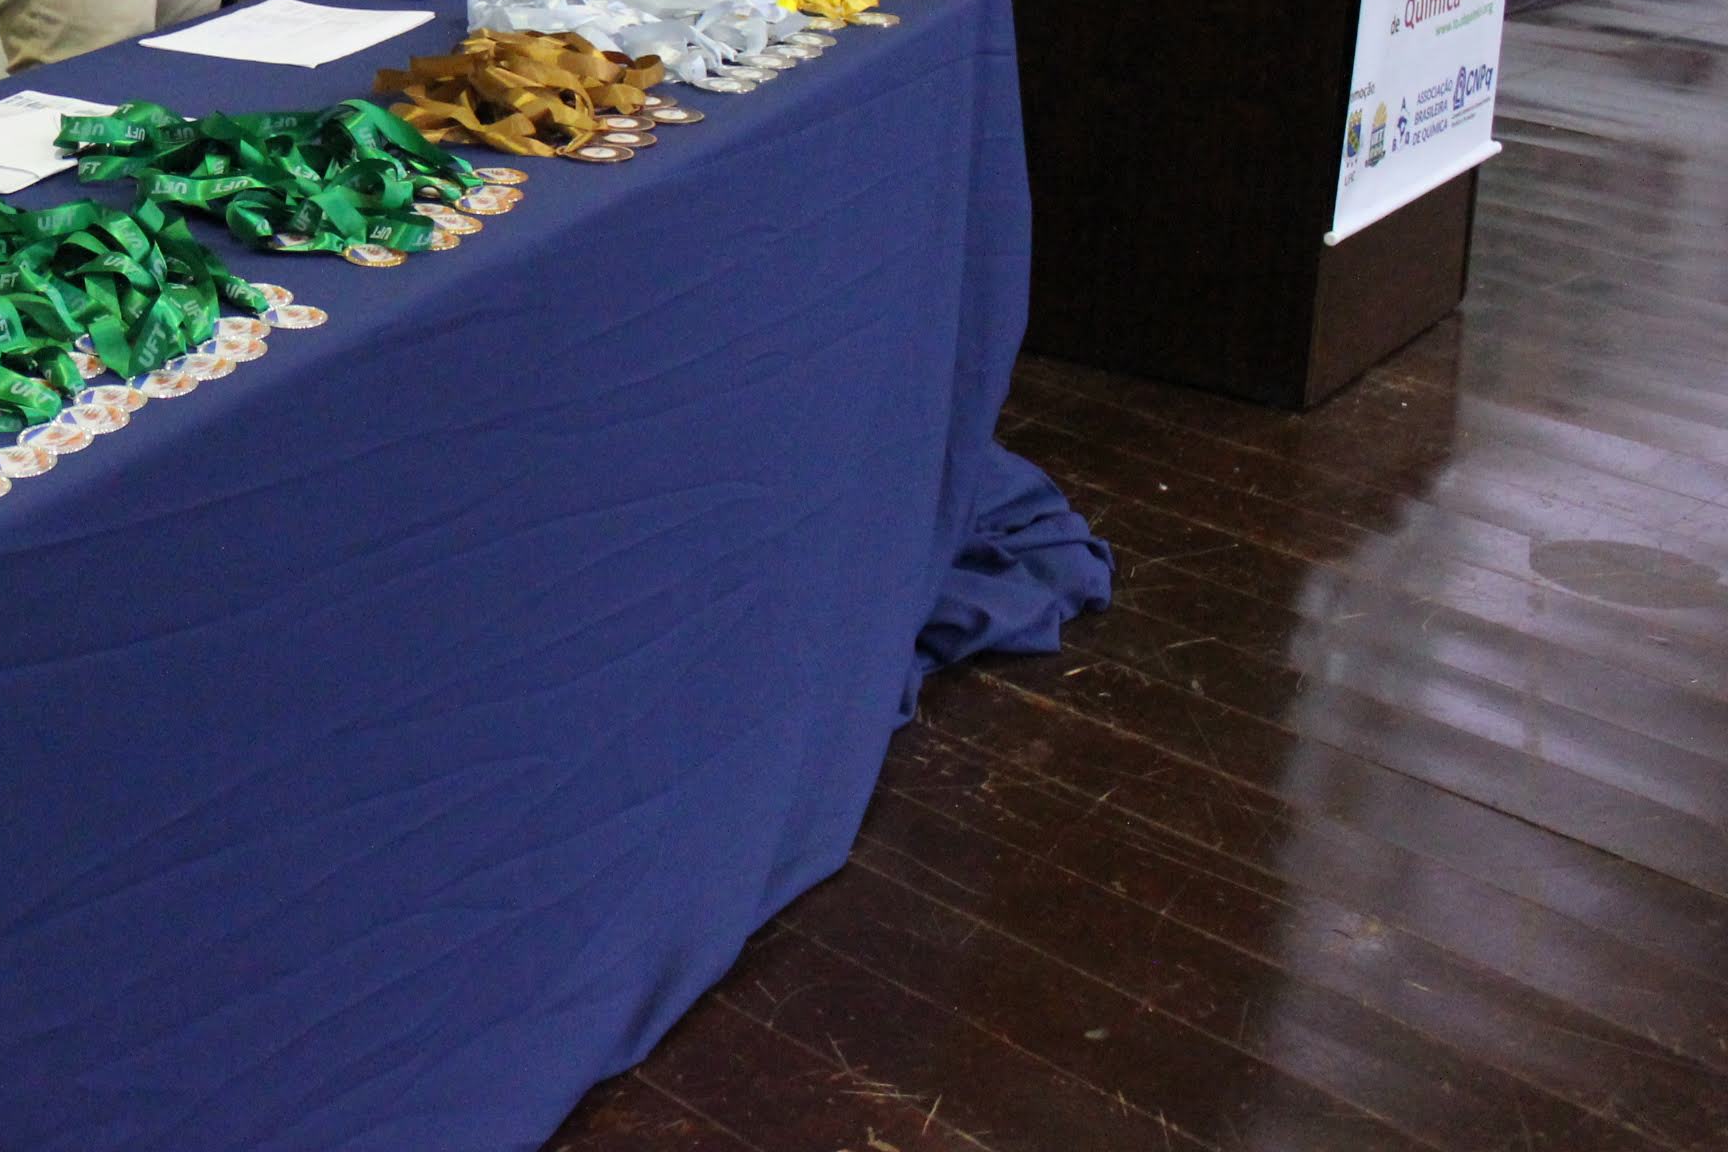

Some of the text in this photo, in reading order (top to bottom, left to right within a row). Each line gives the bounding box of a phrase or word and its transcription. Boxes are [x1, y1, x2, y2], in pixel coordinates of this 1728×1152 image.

[1390, 14, 1401, 35] de
[1465, 64, 1494, 96] CNPq
[125, 125, 146, 141] UFT
[211, 179, 249, 194] UFT
[370, 225, 393, 241] UFT
[139, 323, 167, 368] UFT
